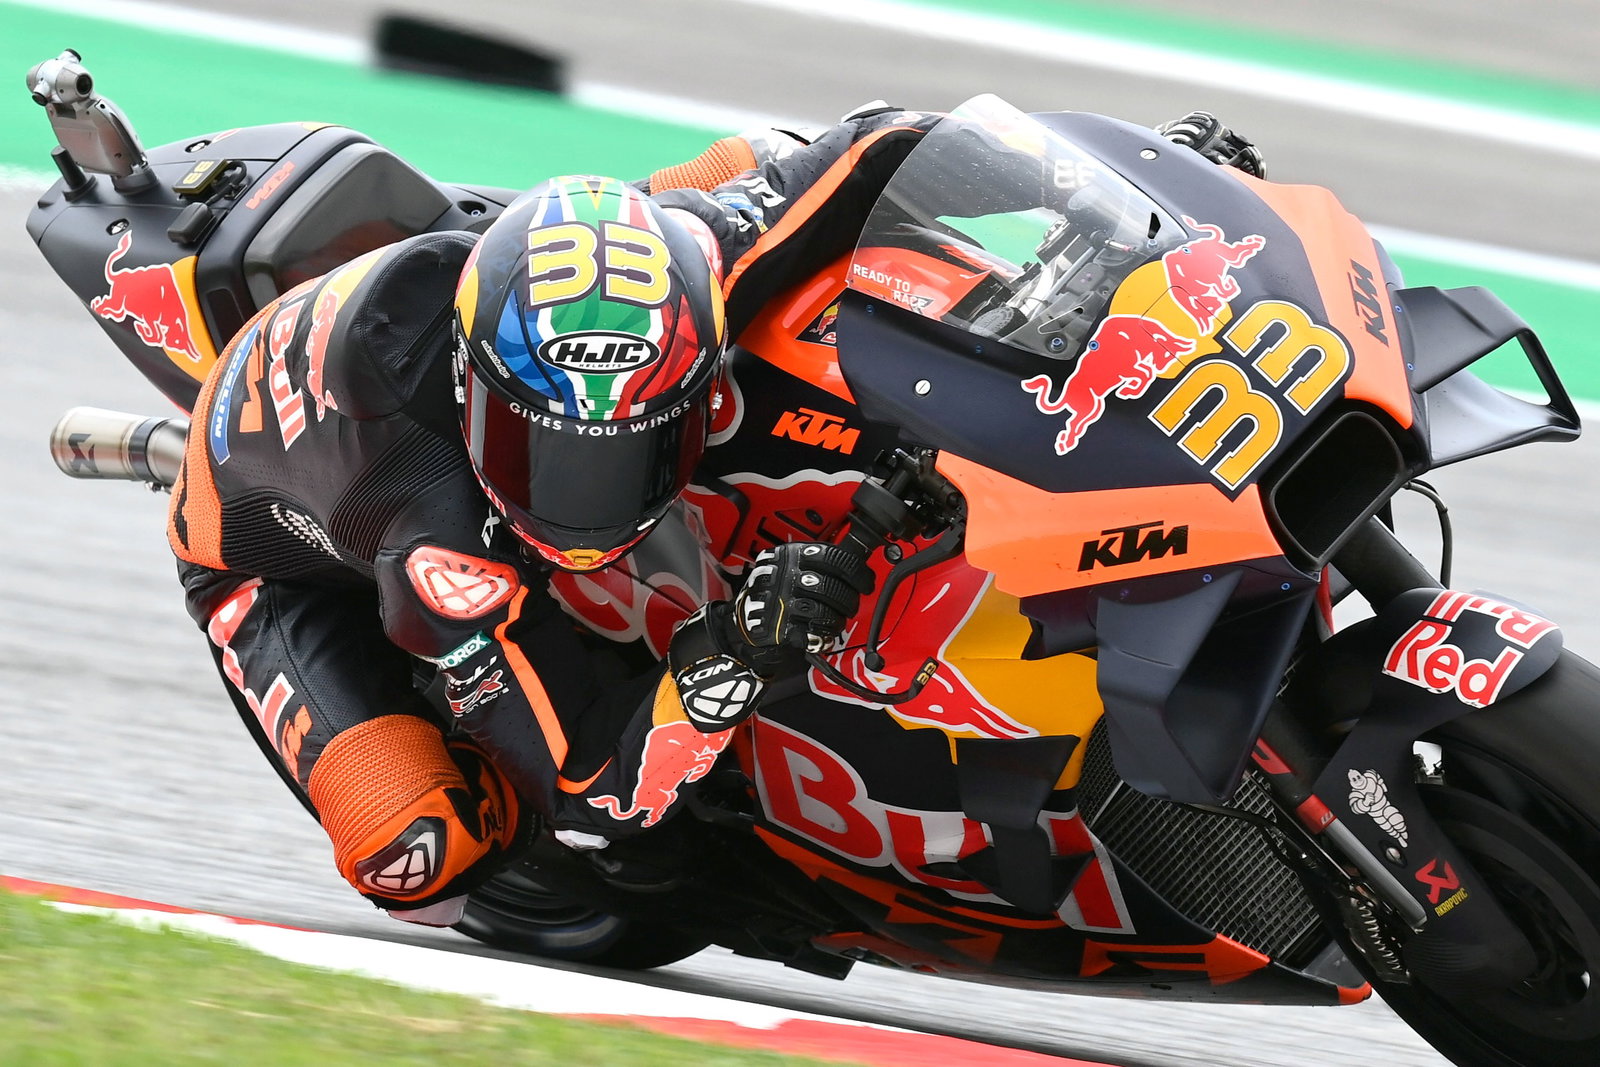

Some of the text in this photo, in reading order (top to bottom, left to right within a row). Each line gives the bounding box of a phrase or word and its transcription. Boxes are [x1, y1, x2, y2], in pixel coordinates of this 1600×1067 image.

[528, 221, 671, 306] 33
[853, 264, 911, 293] READY TO
[893, 290, 929, 310] RACE
[1351, 259, 1390, 347] KTM
[554, 342, 645, 363] HJC
[1147, 300, 1351, 491] 33
[509, 399, 691, 437] GIVES YOU WINGS
[771, 407, 861, 455] KTM
[1079, 521, 1189, 572] KTM
[438, 634, 489, 670] TOREX
[1381, 618, 1526, 709] Red
[680, 660, 734, 686] XON
[916, 662, 937, 686] 33
